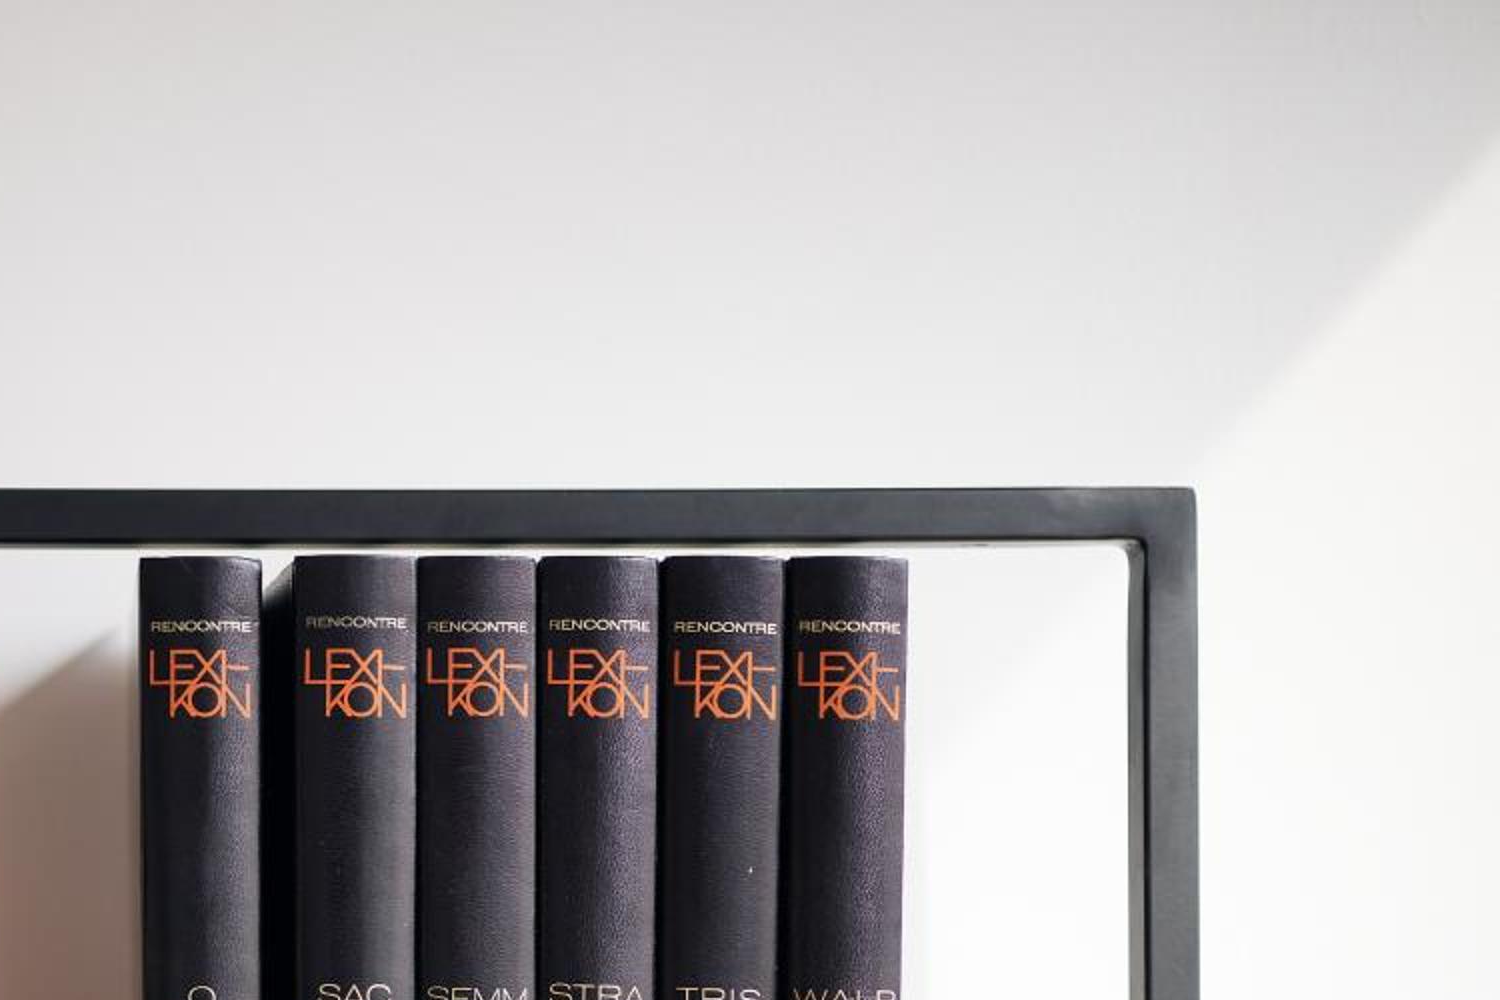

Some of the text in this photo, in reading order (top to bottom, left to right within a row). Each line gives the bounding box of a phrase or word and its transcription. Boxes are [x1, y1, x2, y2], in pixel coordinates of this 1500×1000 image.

[150, 619, 253, 633] RENCONTRE
[306, 615, 407, 630] RENCONTRE
[427, 620, 528, 634] RENCONTRE
[549, 618, 650, 633] RENCONTRE
[673, 620, 777, 635] RENCONTRE
[799, 619, 900, 635] RENCONTRE
